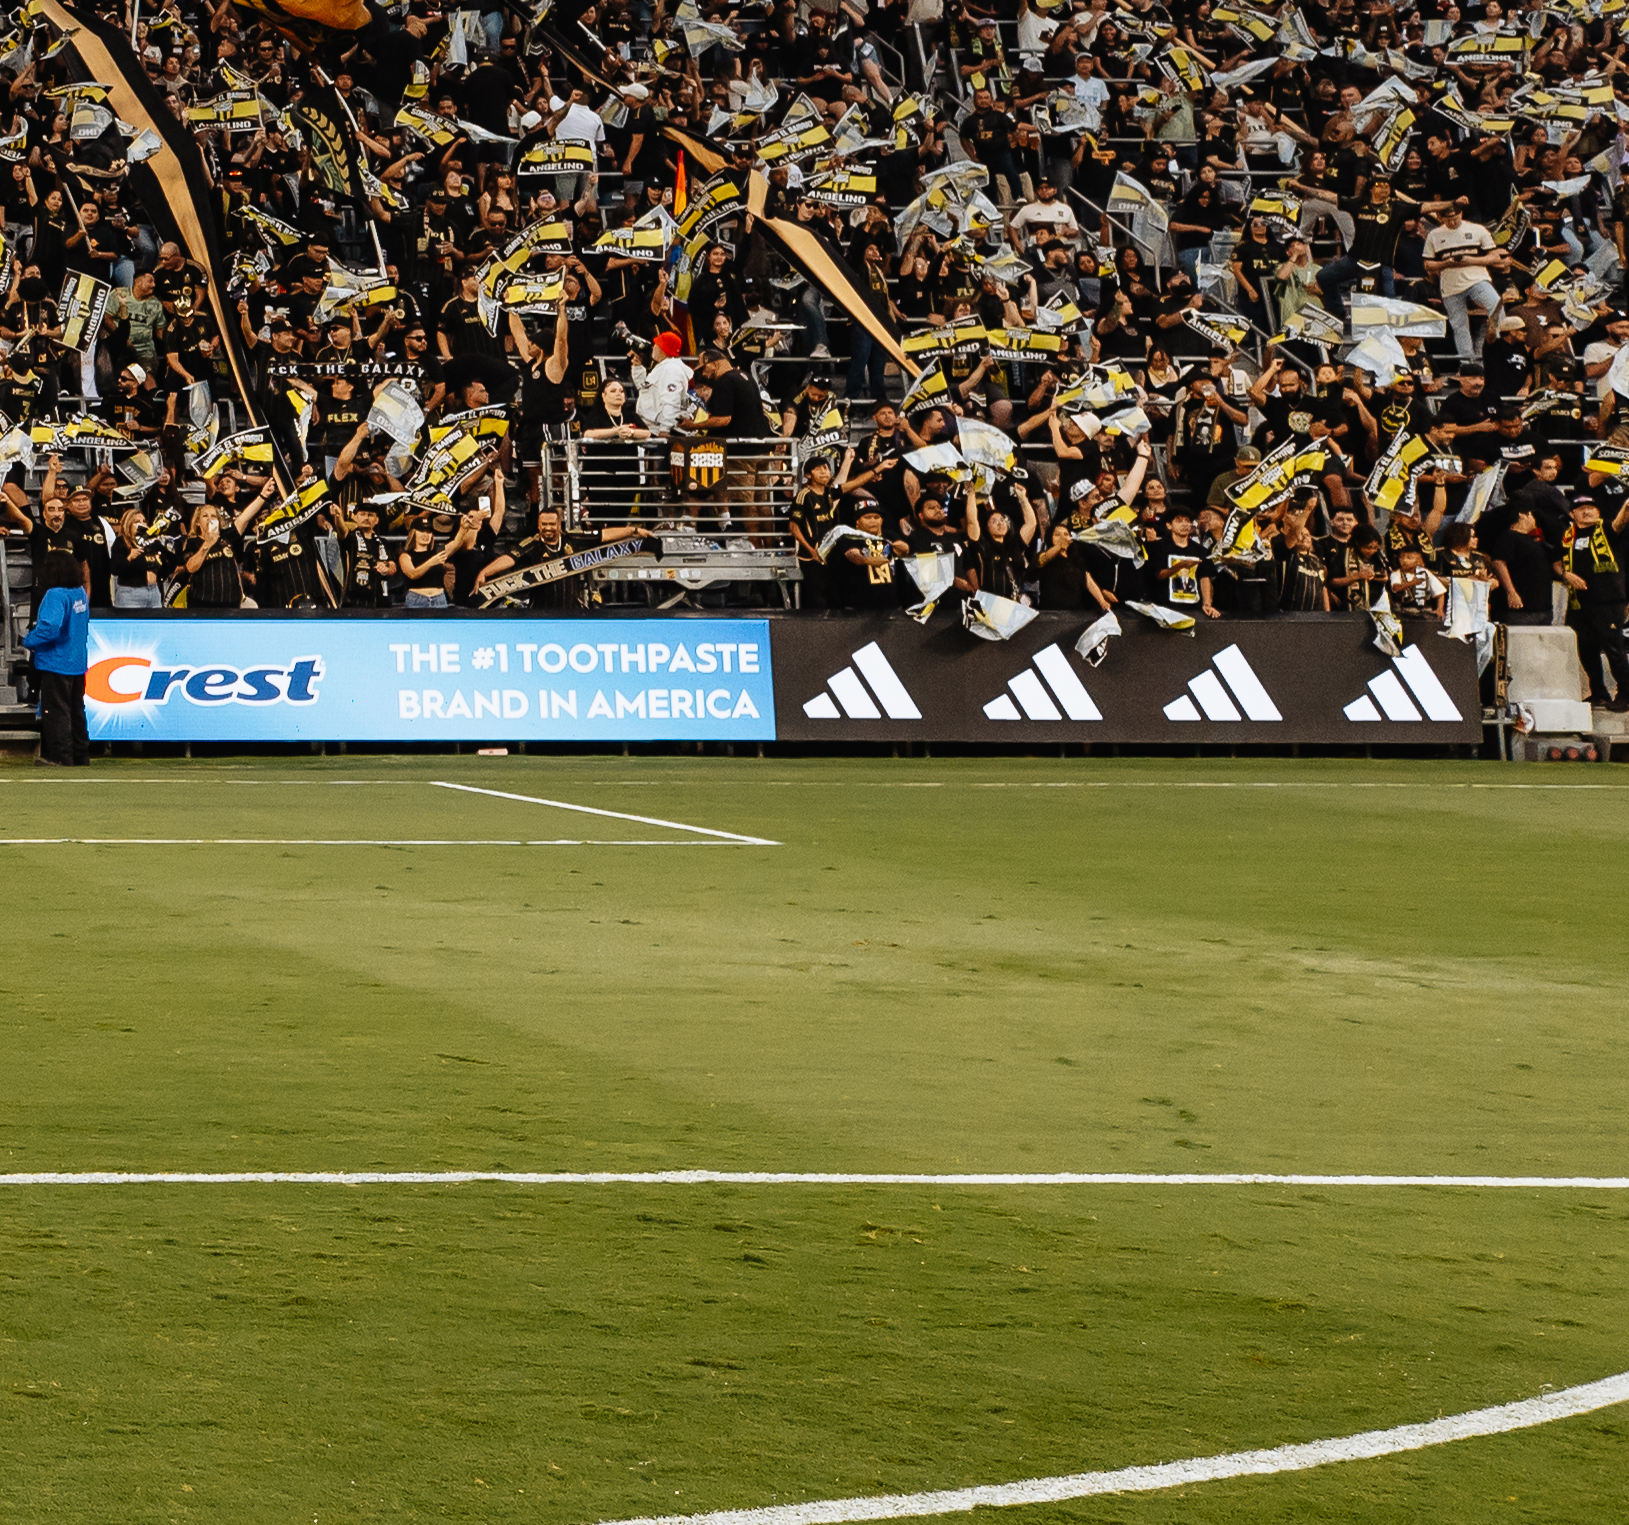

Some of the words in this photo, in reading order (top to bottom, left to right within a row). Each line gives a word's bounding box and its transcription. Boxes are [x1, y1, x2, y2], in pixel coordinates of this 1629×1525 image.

[411, 108, 433, 123] SOMOS
[529, 161, 584, 173] ANGELINO
[807, 191, 867, 205] ANGELINO
[83, 288, 107, 343] ANGELINO
[315, 364, 345, 375] THE
[361, 364, 425, 378] GALAXY
[327, 412, 359, 424] FLEX
[690, 452, 724, 468] 3252
[267, 500, 323, 538] ANGELINO
[479, 574, 530, 601] FUCK
[530, 559, 568, 581] THE
[570, 539, 644, 571] GALAXY
[389, 644, 463, 674] THE
[471, 644, 510, 674] #1
[516, 644, 760, 674] TOOTHPASTE
[85, 655, 322, 706] Crest
[399, 689, 532, 719] BRAND
[541, 689, 577, 719] IN
[586, 689, 760, 719] AMERICA
